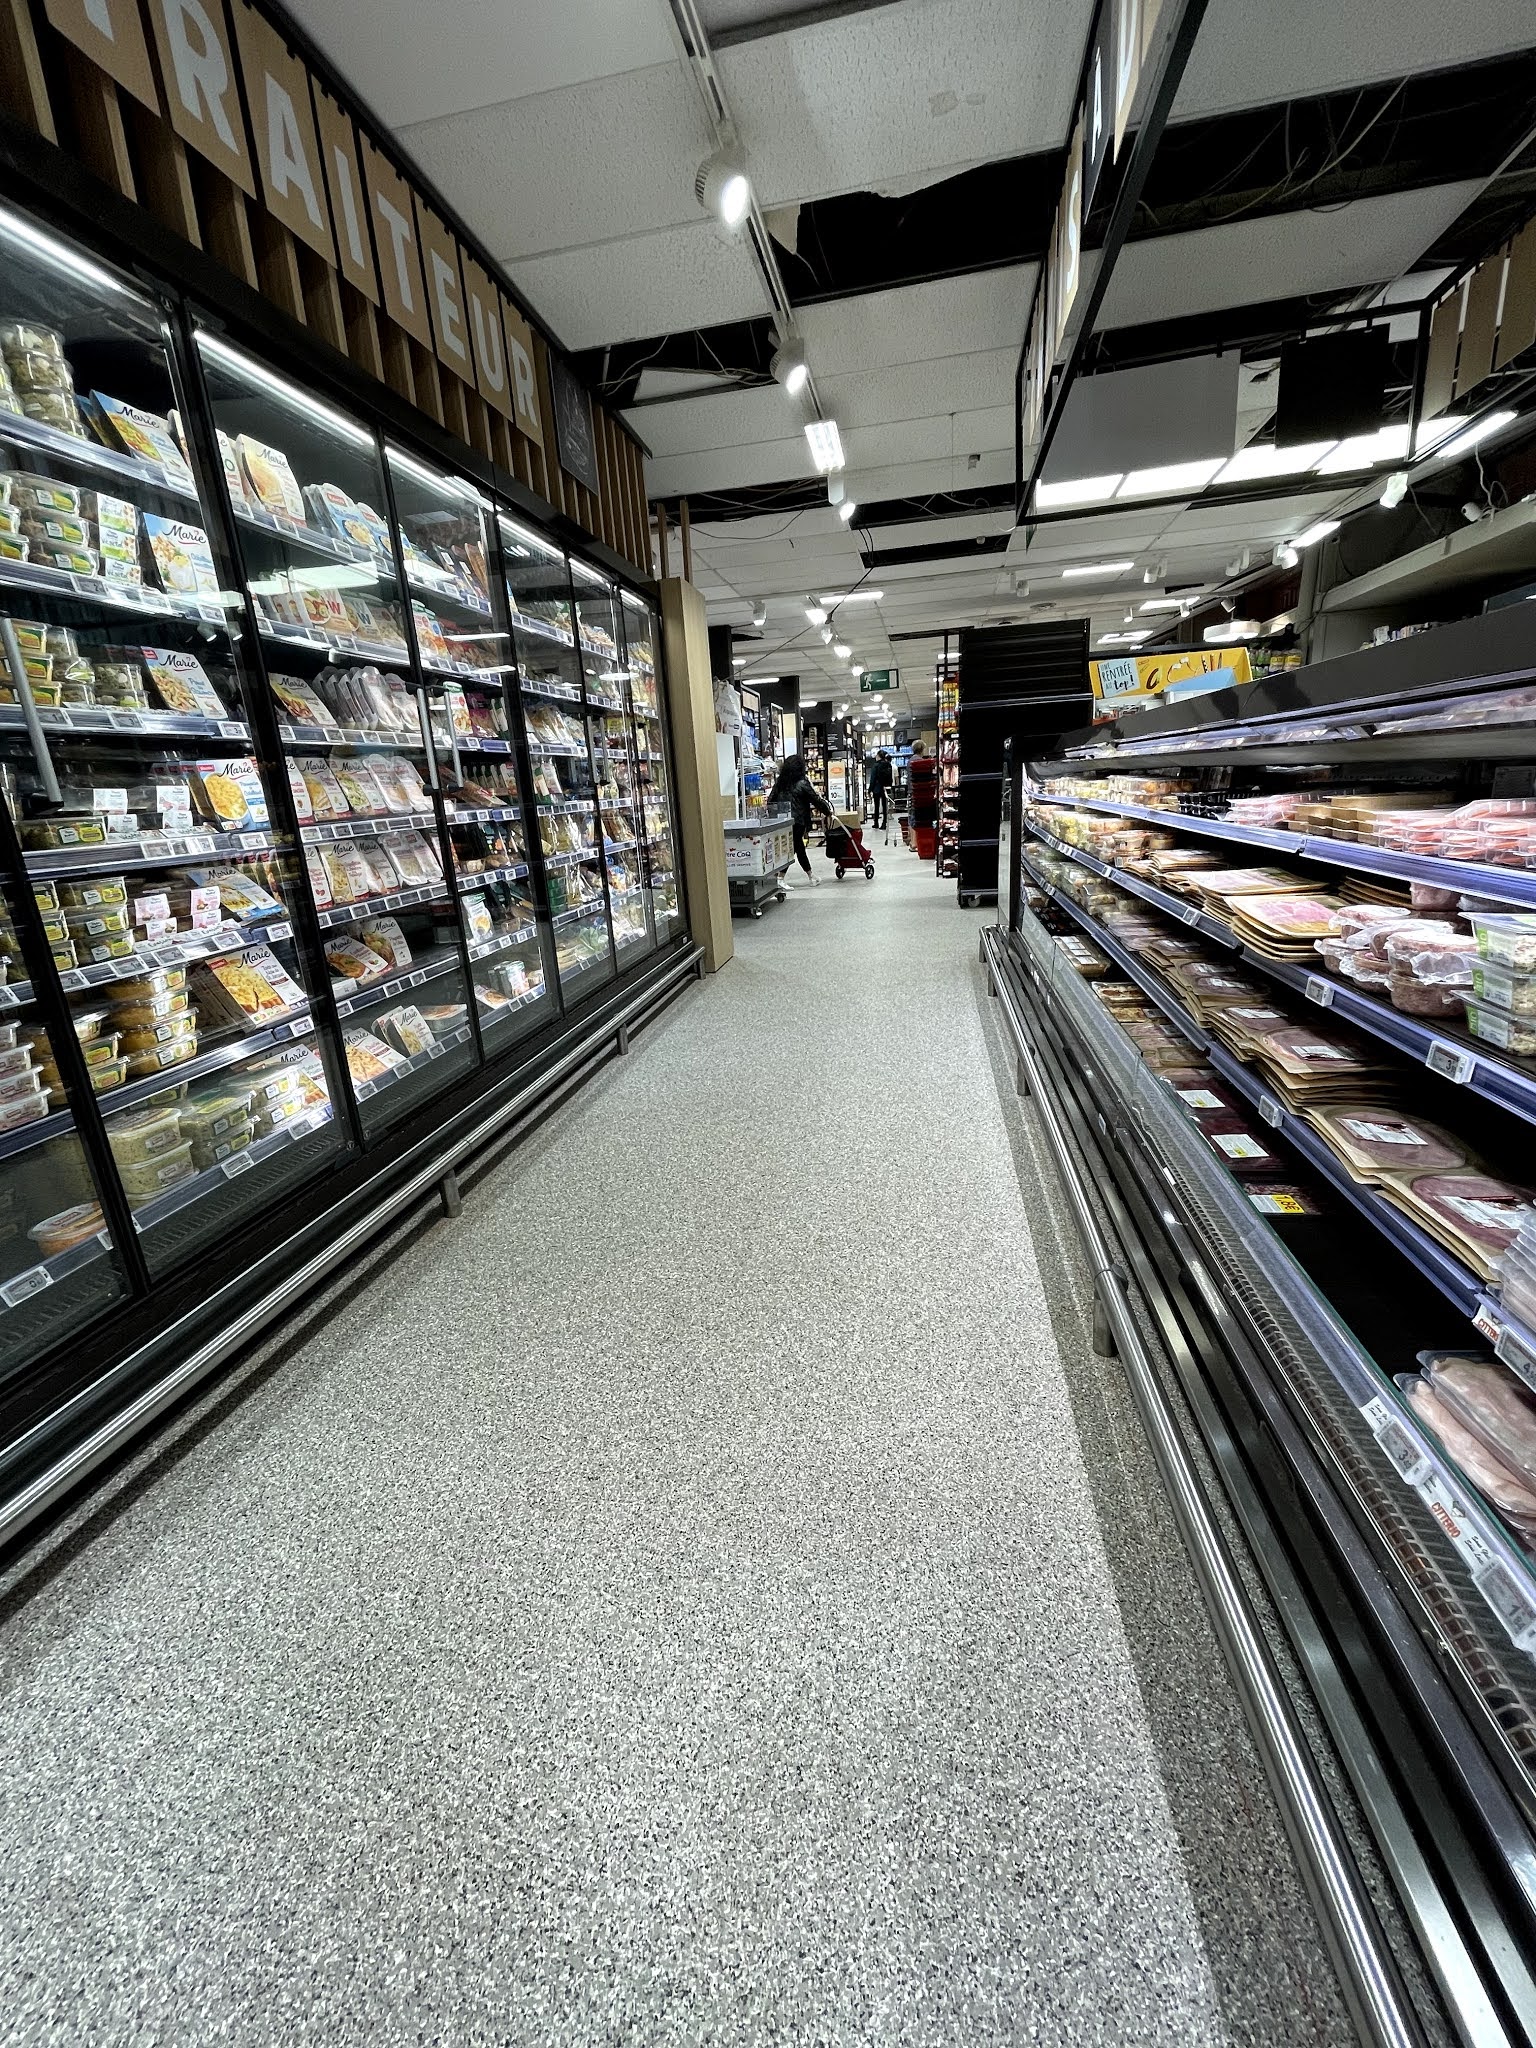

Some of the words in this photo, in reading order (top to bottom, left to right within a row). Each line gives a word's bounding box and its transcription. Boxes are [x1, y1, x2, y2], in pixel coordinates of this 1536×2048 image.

[116, 406, 160, 429] Marie
[256, 448, 288, 469] Marie
[162, 524, 206, 544] Marie
[159, 654, 199, 669] Marie
[1101, 660, 1133, 682] RENTRÉE
[278, 677, 308, 689] Marie
[216, 761, 253, 778] Marie
[301, 760, 328, 772] Marie
[340, 761, 363, 772] Marie
[329, 842, 355, 857] Marie
[358, 840, 379, 853] Marie
[207, 865, 237, 881] Marie
[370, 920, 396, 934] Marie
[328, 937, 353, 956] Marie
[236, 947, 271, 969] Marie
[400, 1008, 418, 1027] Marie
[343, 1030, 369, 1047] Marie
[280, 1046, 309, 1063] Marie
[1431, 1501, 1462, 1539] CITTERIO
